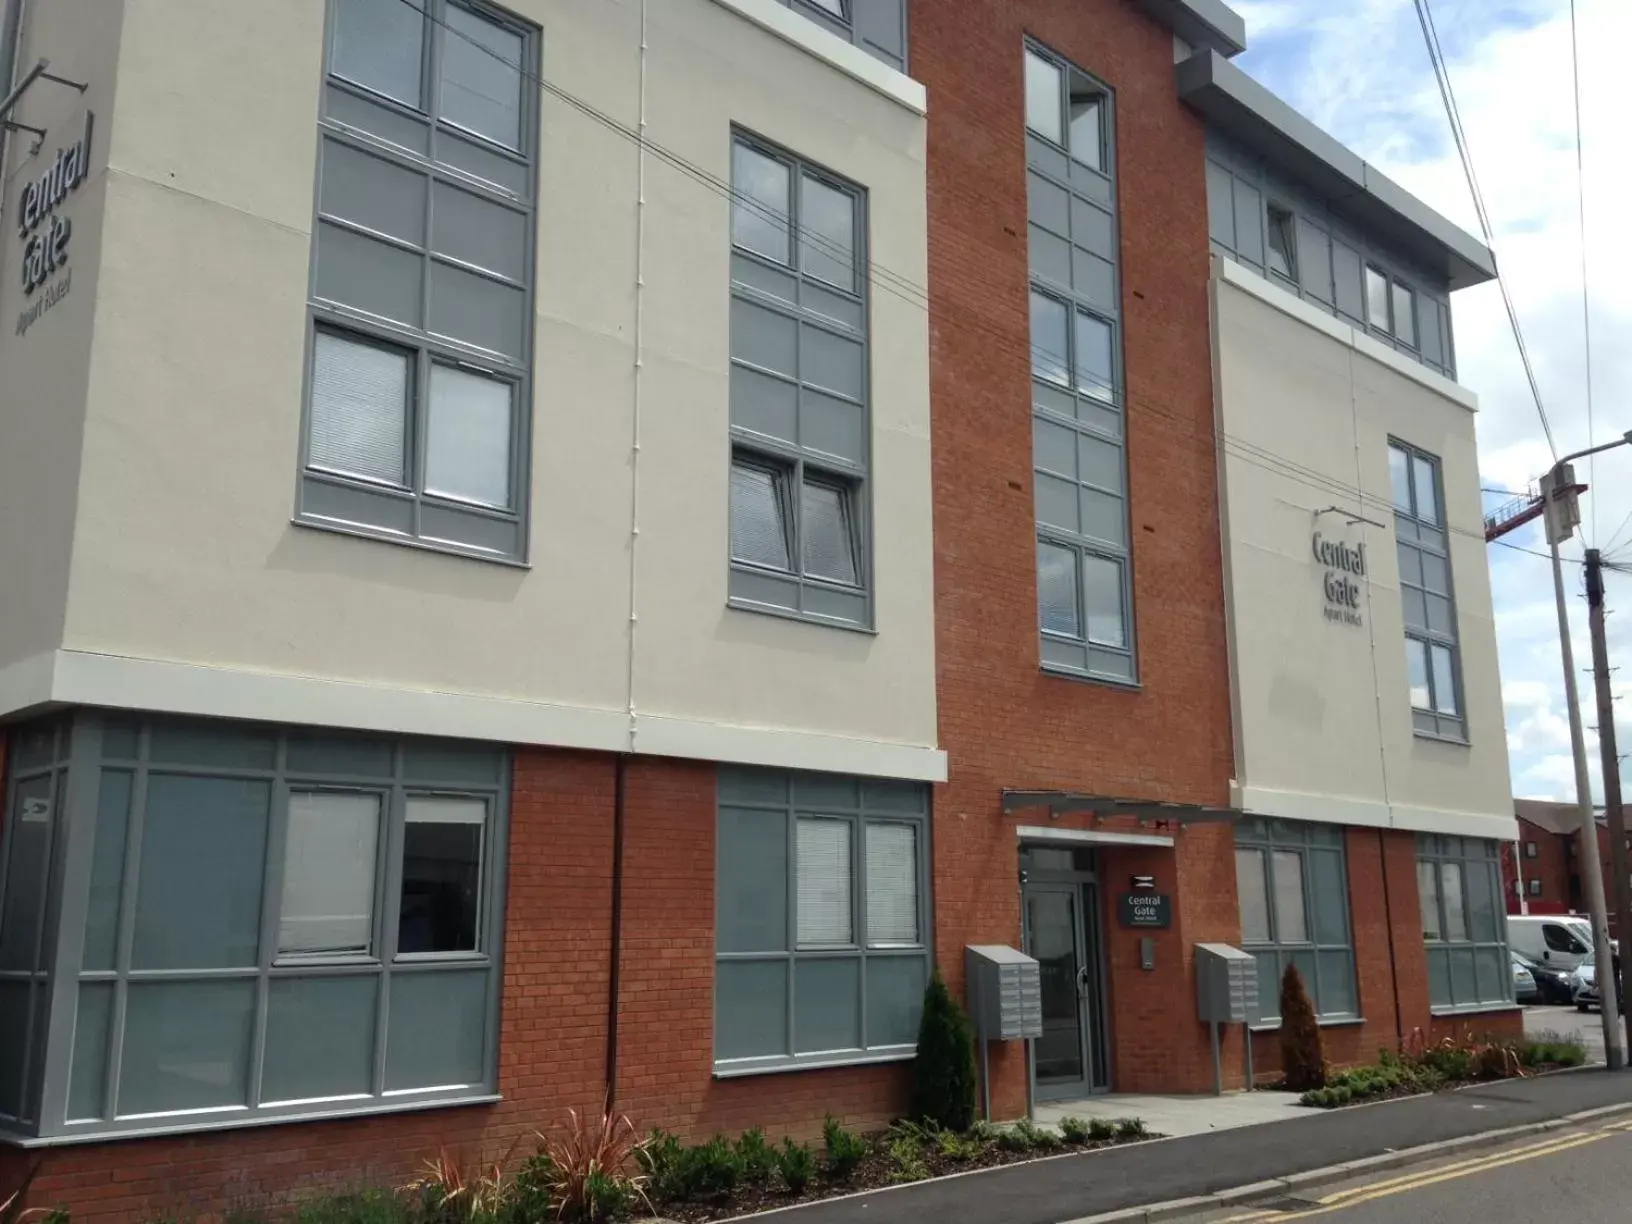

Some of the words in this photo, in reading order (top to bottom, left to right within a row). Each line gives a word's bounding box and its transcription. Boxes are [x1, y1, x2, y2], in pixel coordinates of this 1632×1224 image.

[19, 109, 95, 238] Central
[23, 215, 71, 295] Gate
[1312, 531, 1366, 576] Central
[1324, 570, 1359, 609] Gate
[1128, 896, 1161, 905] Central
[1134, 906, 1157, 915] Gate
